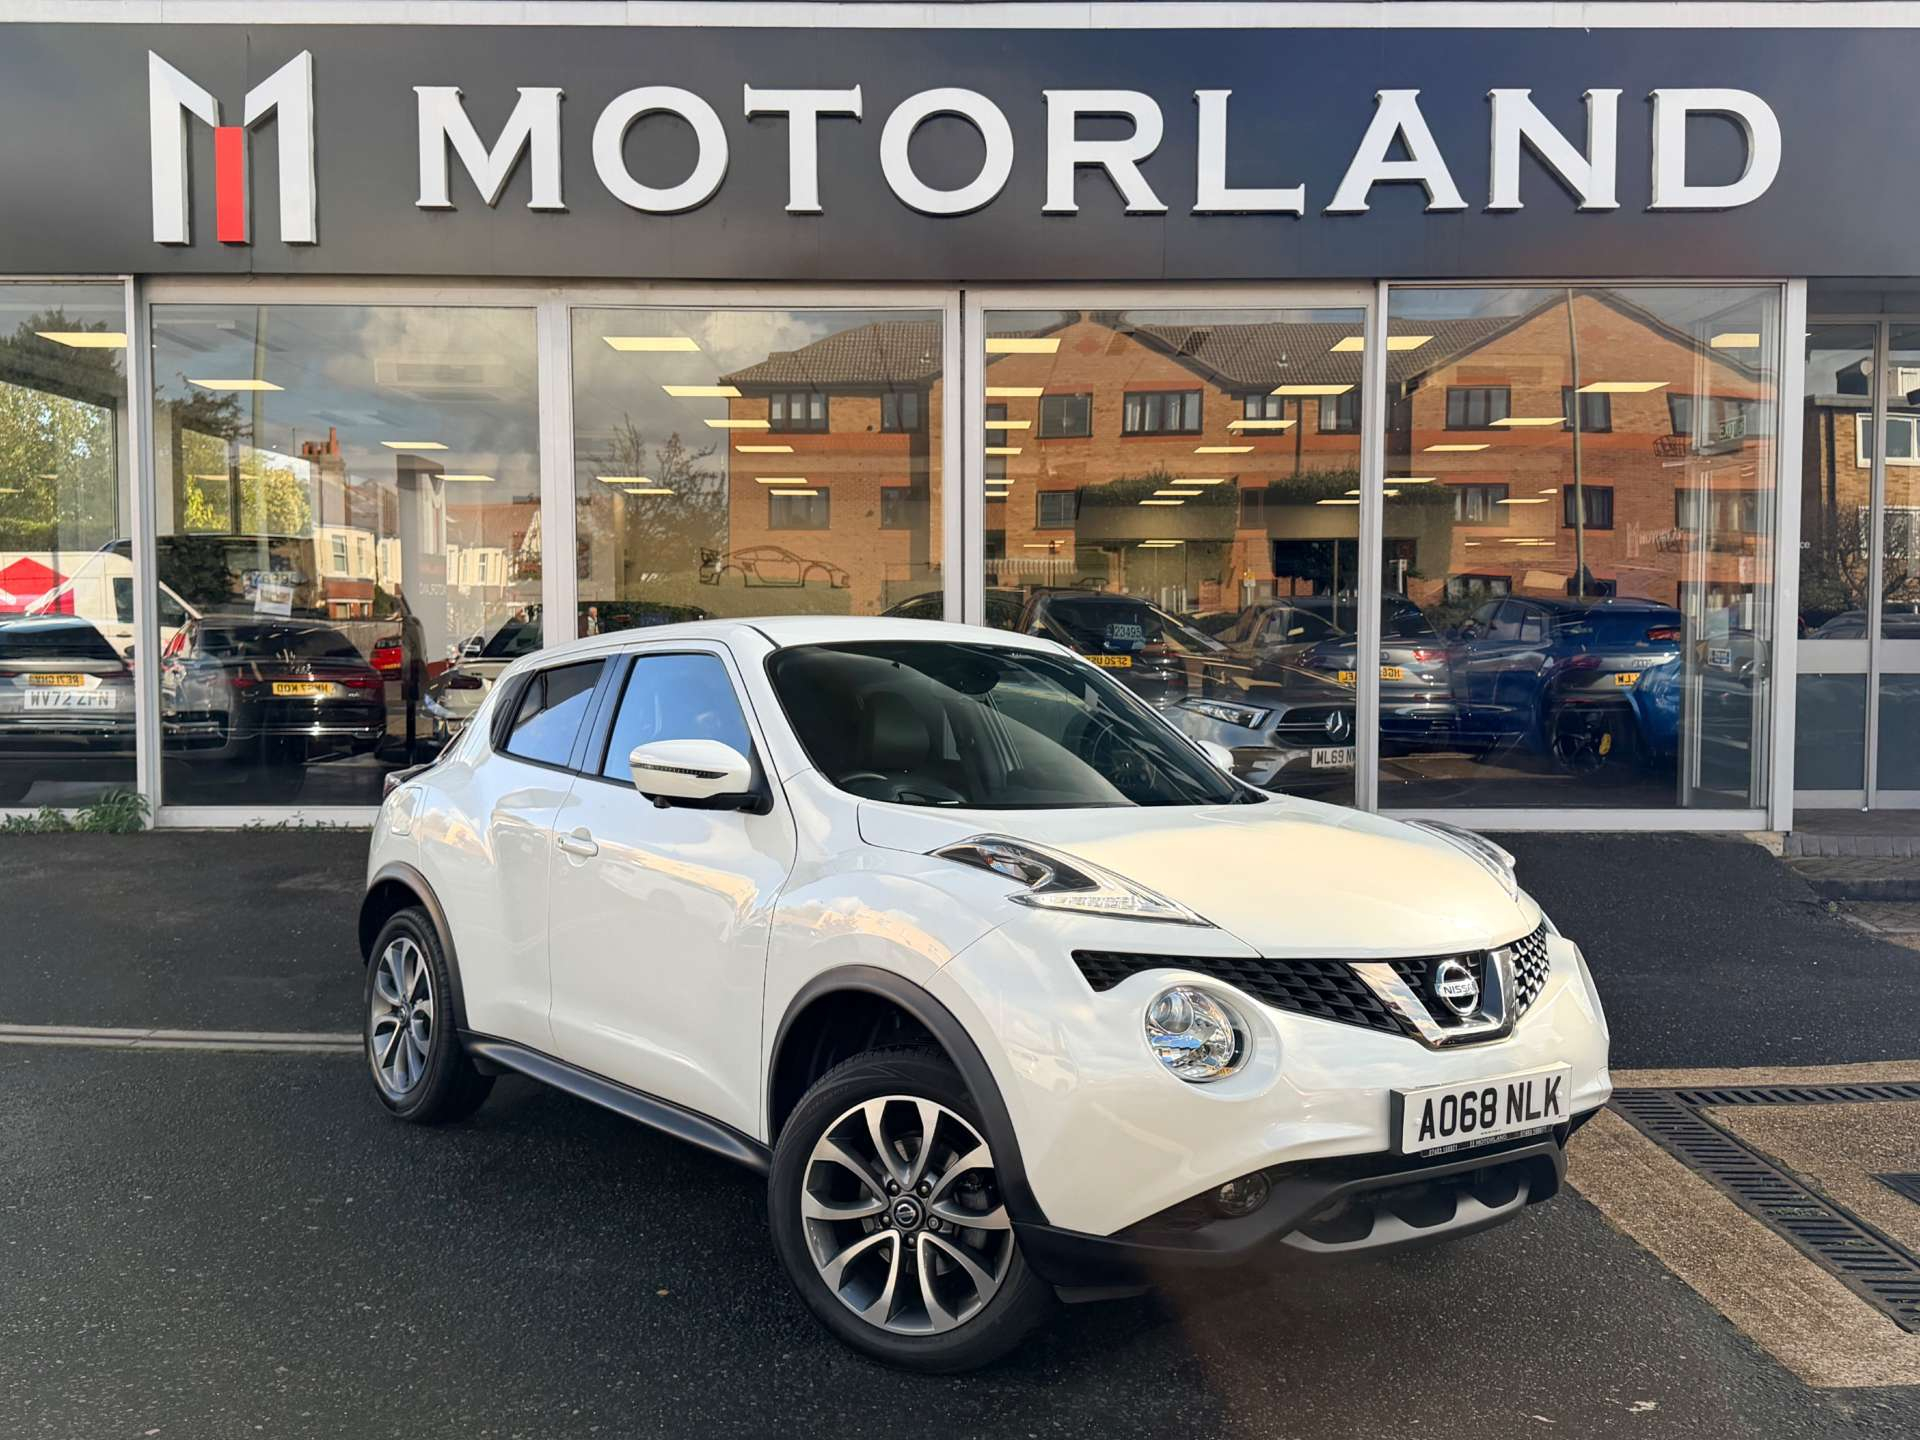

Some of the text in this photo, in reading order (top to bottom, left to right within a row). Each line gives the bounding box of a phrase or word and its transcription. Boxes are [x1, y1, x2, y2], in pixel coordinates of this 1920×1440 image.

[412, 84, 1783, 216] MOTORLAND
[30, 690, 72, 706] WV72
[1316, 749, 1345, 765] ML69
[1418, 1076, 1562, 1142] AO68 NLK
